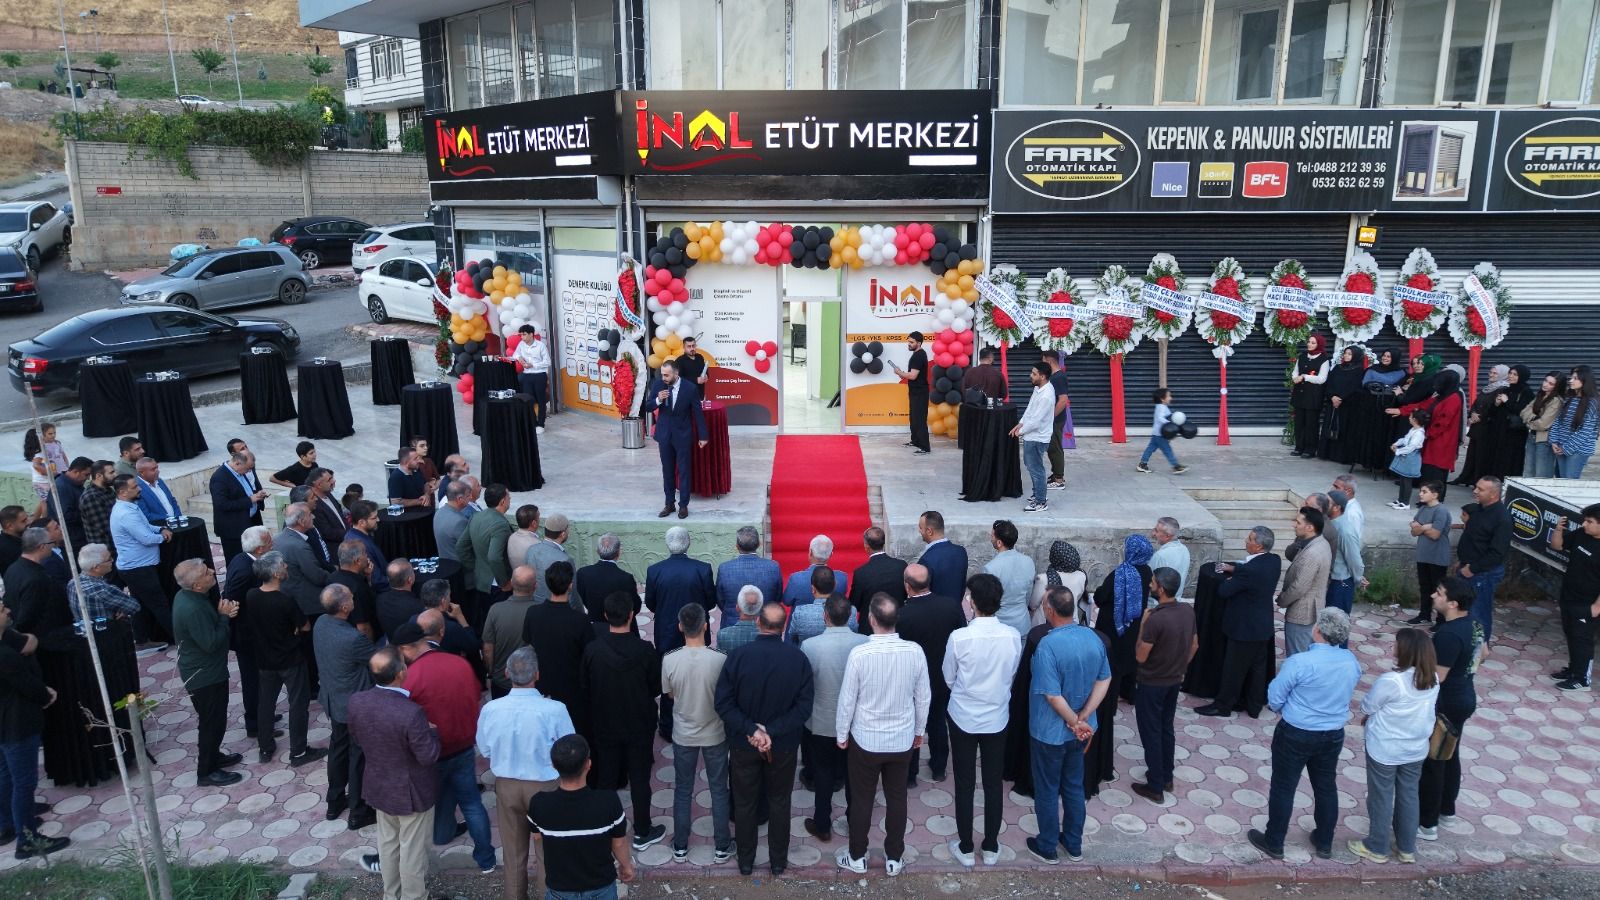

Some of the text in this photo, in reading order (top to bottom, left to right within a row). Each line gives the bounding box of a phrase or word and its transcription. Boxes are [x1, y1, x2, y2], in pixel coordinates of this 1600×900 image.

[635, 99, 979, 166] İNAL ETÜT MERKEZİ
[1147, 120, 1394, 150] KEPENK & PANJUR SİSTEMLERİ
[435, 116, 590, 172] İNAL ETÜT MERKEZİ
[1024, 147, 1118, 162] FARK
[1523, 145, 1600, 161] FAR
[1026, 162, 1117, 172] OTOMATİK KAPI
[1296, 162, 1387, 173] Tel:0488 212 39 36
[1524, 161, 1586, 171] OTOMATİK
[1162, 183, 1183, 192] Nice
[1312, 177, 1385, 188] 0532 632 62 59
[568, 279, 612, 292] DENEME KULÜBÜ
[869, 278, 936, 313] İNAL
[1011, 304, 1034, 332] PERDE
[1511, 507, 1537, 525] FARK
